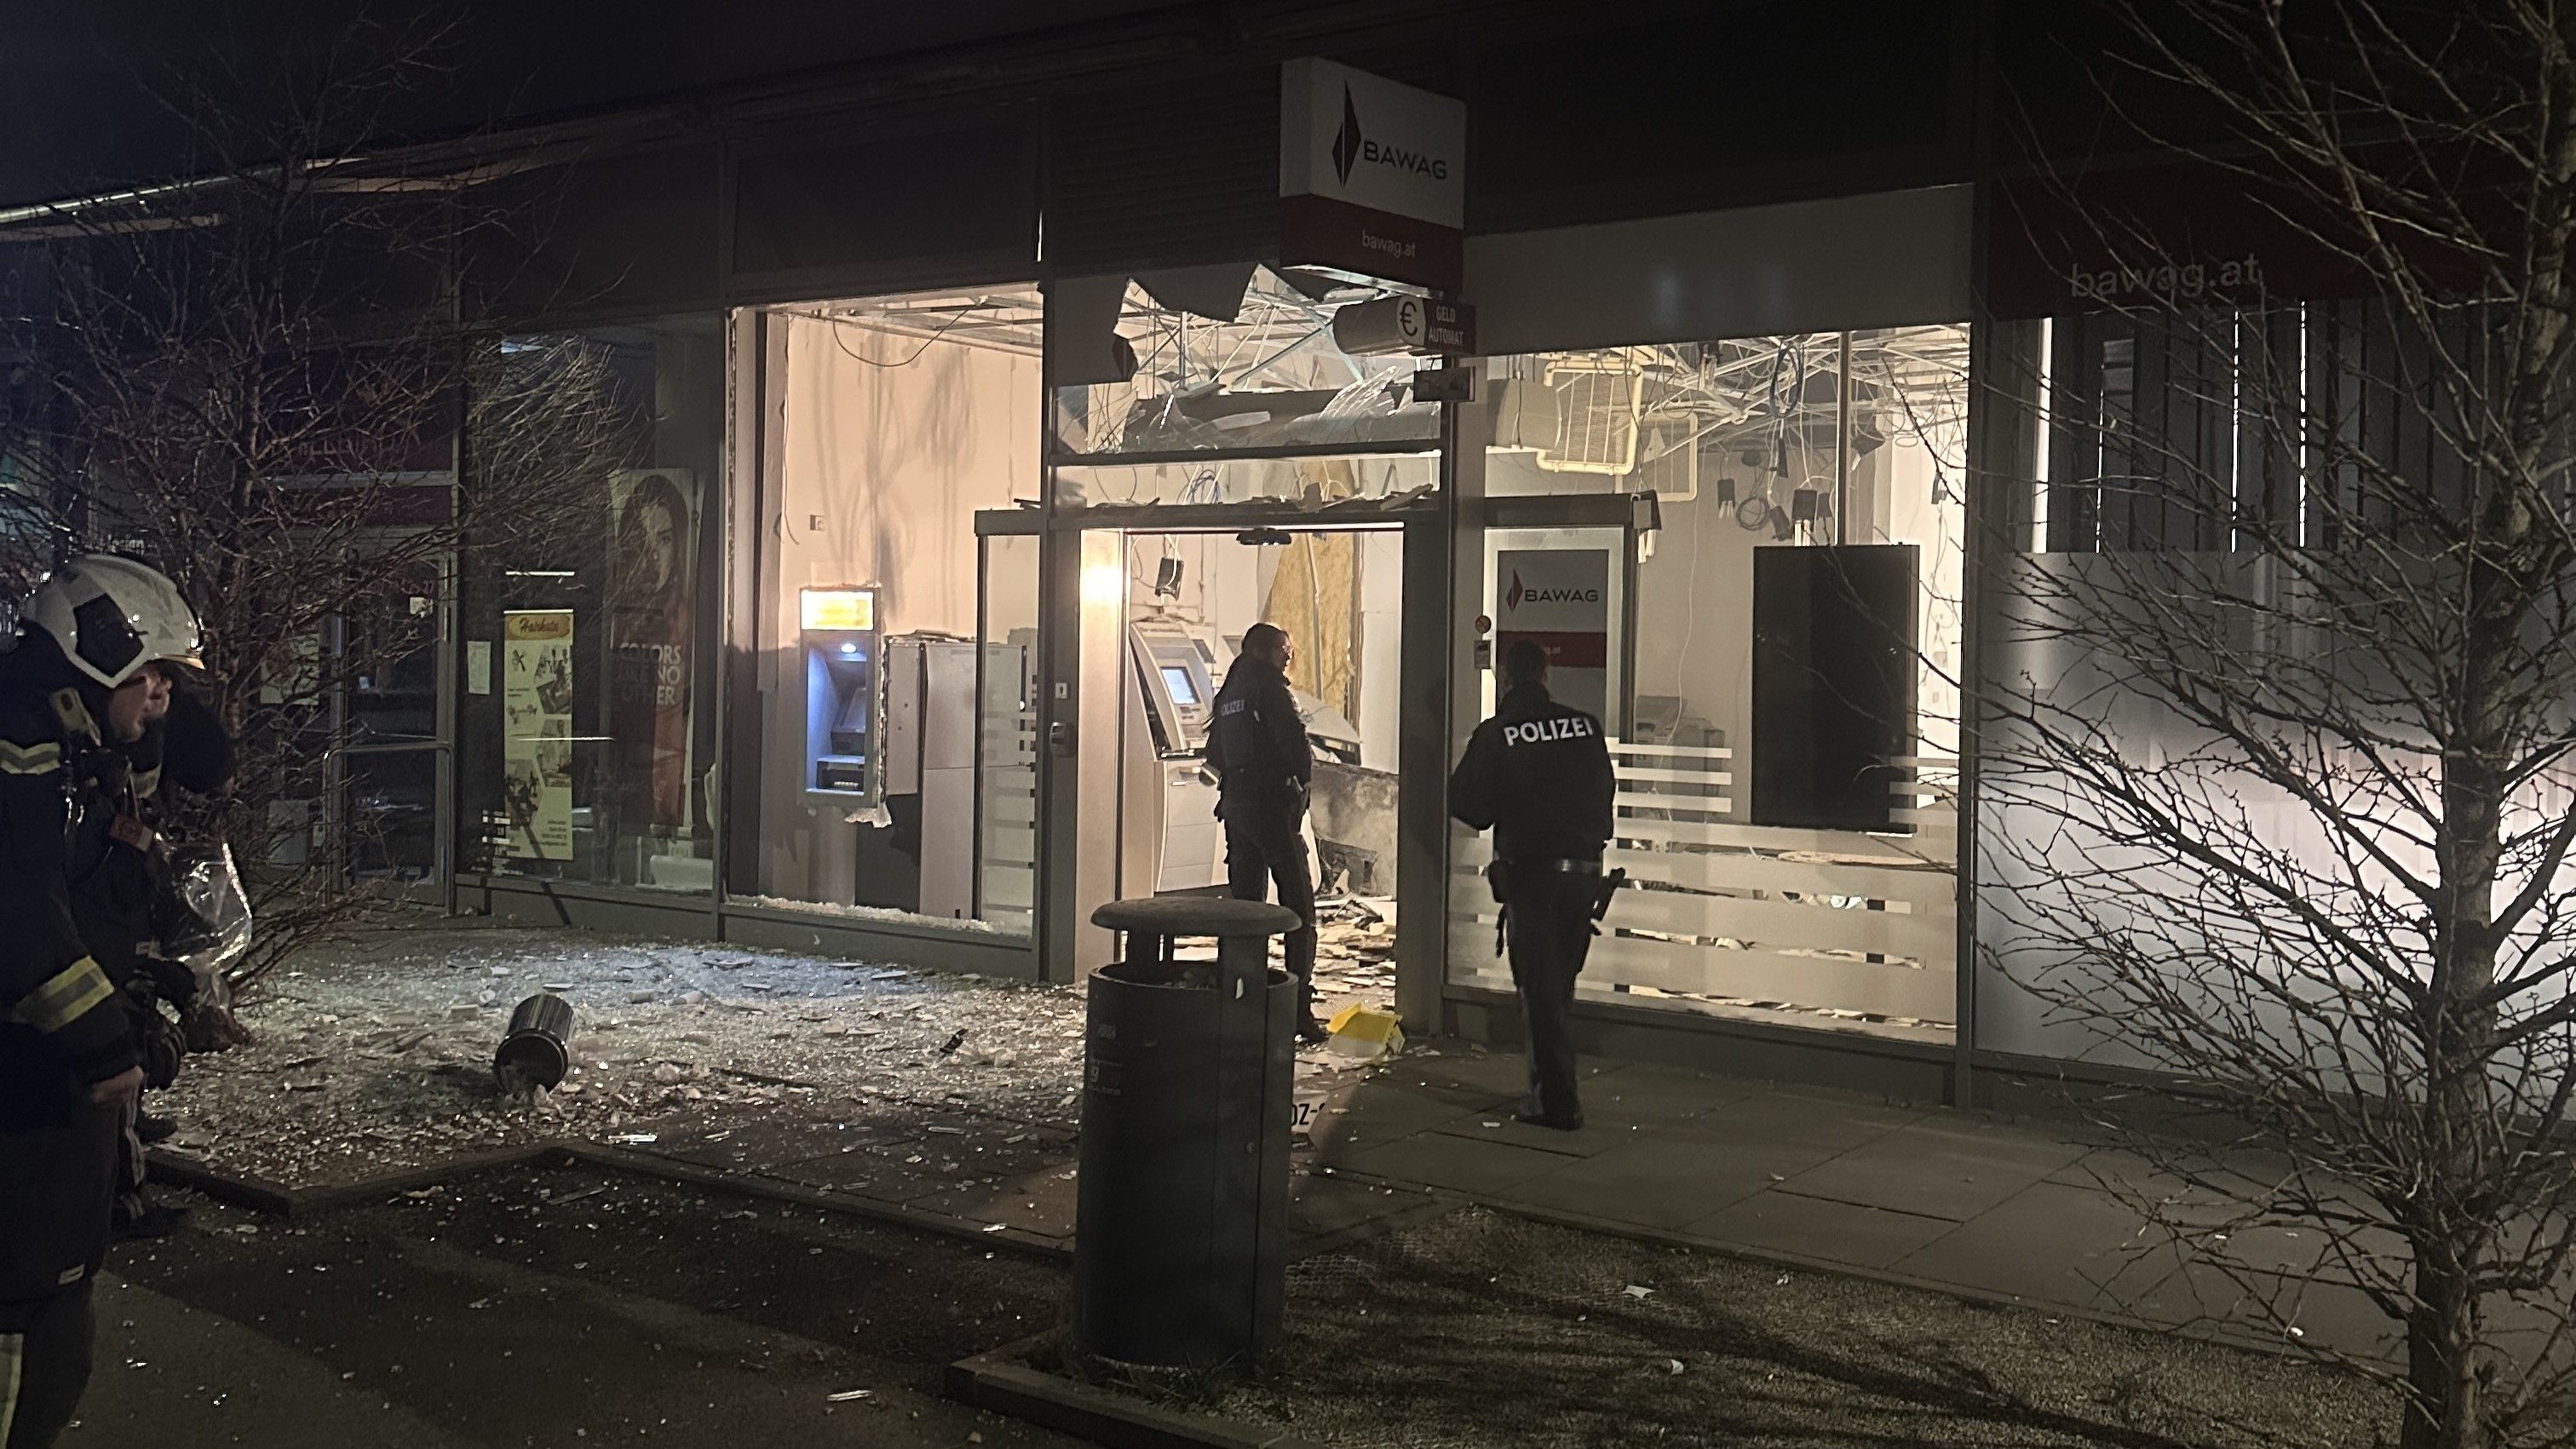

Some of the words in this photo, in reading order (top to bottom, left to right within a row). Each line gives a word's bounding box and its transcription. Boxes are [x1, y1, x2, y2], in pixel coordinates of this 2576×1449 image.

[1363, 140, 1446, 180] BAWAG
[1362, 229, 1416, 257] bawag.at
[2071, 253, 2261, 298] bawag.at
[1435, 306, 1456, 324] GELD
[1429, 327, 1464, 345] AUTOMAT
[1524, 589, 1599, 602] BAWAG
[1504, 717, 1594, 747] POLIZEI
